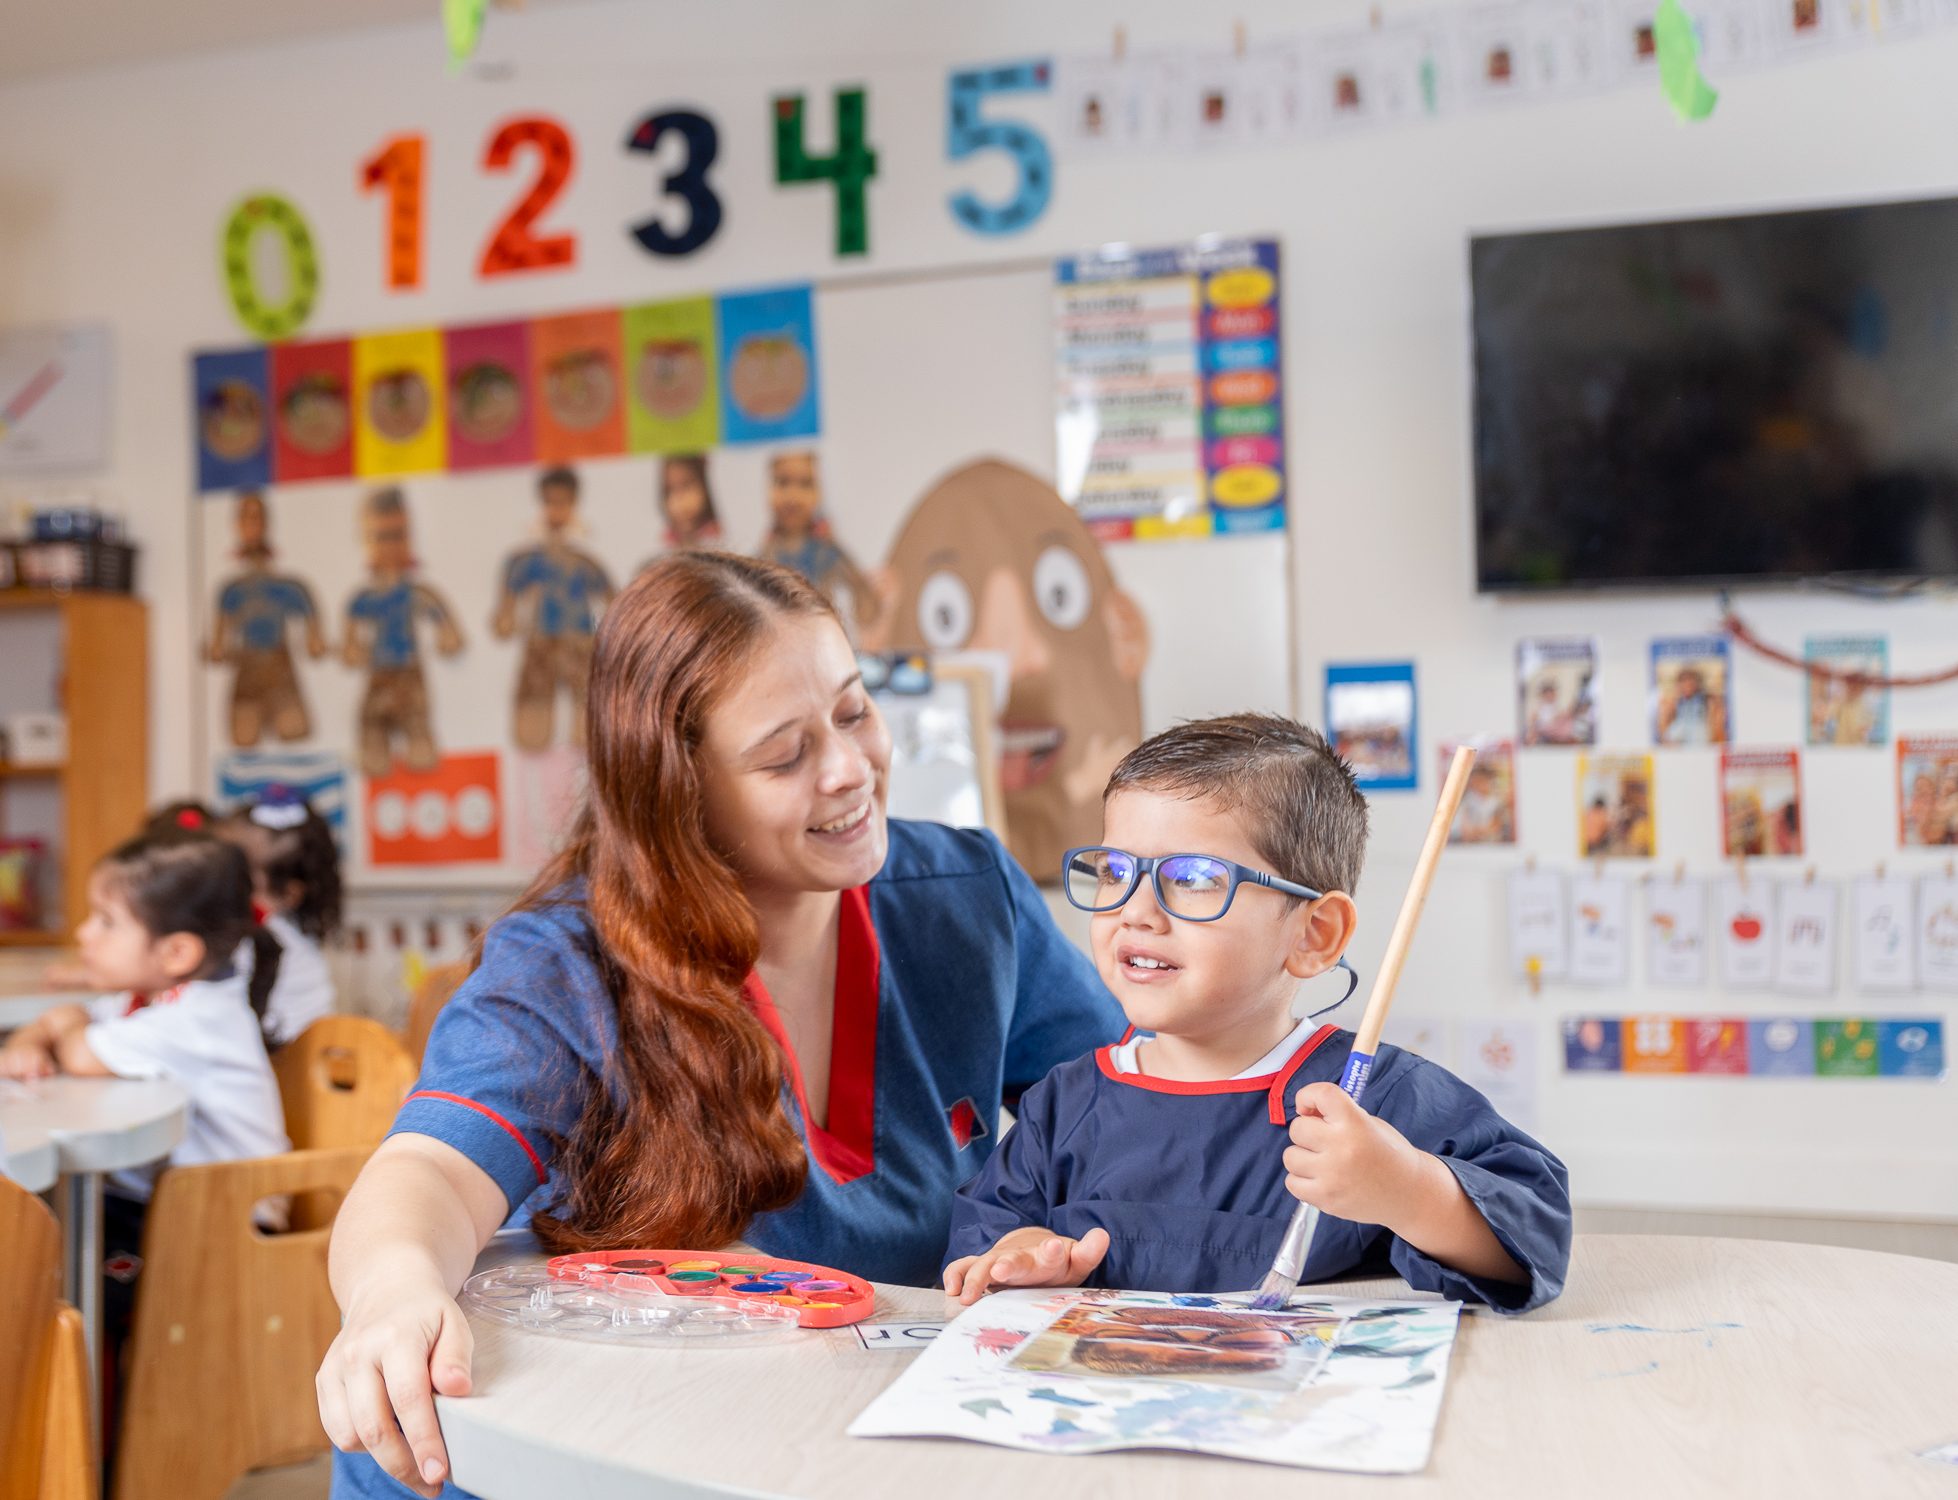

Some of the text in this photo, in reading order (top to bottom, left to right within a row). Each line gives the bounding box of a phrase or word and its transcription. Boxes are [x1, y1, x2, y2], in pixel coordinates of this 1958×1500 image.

[223, 59, 1053, 340] 0 1 2 3 4 5
[1343, 1059, 1362, 1093] istophe
